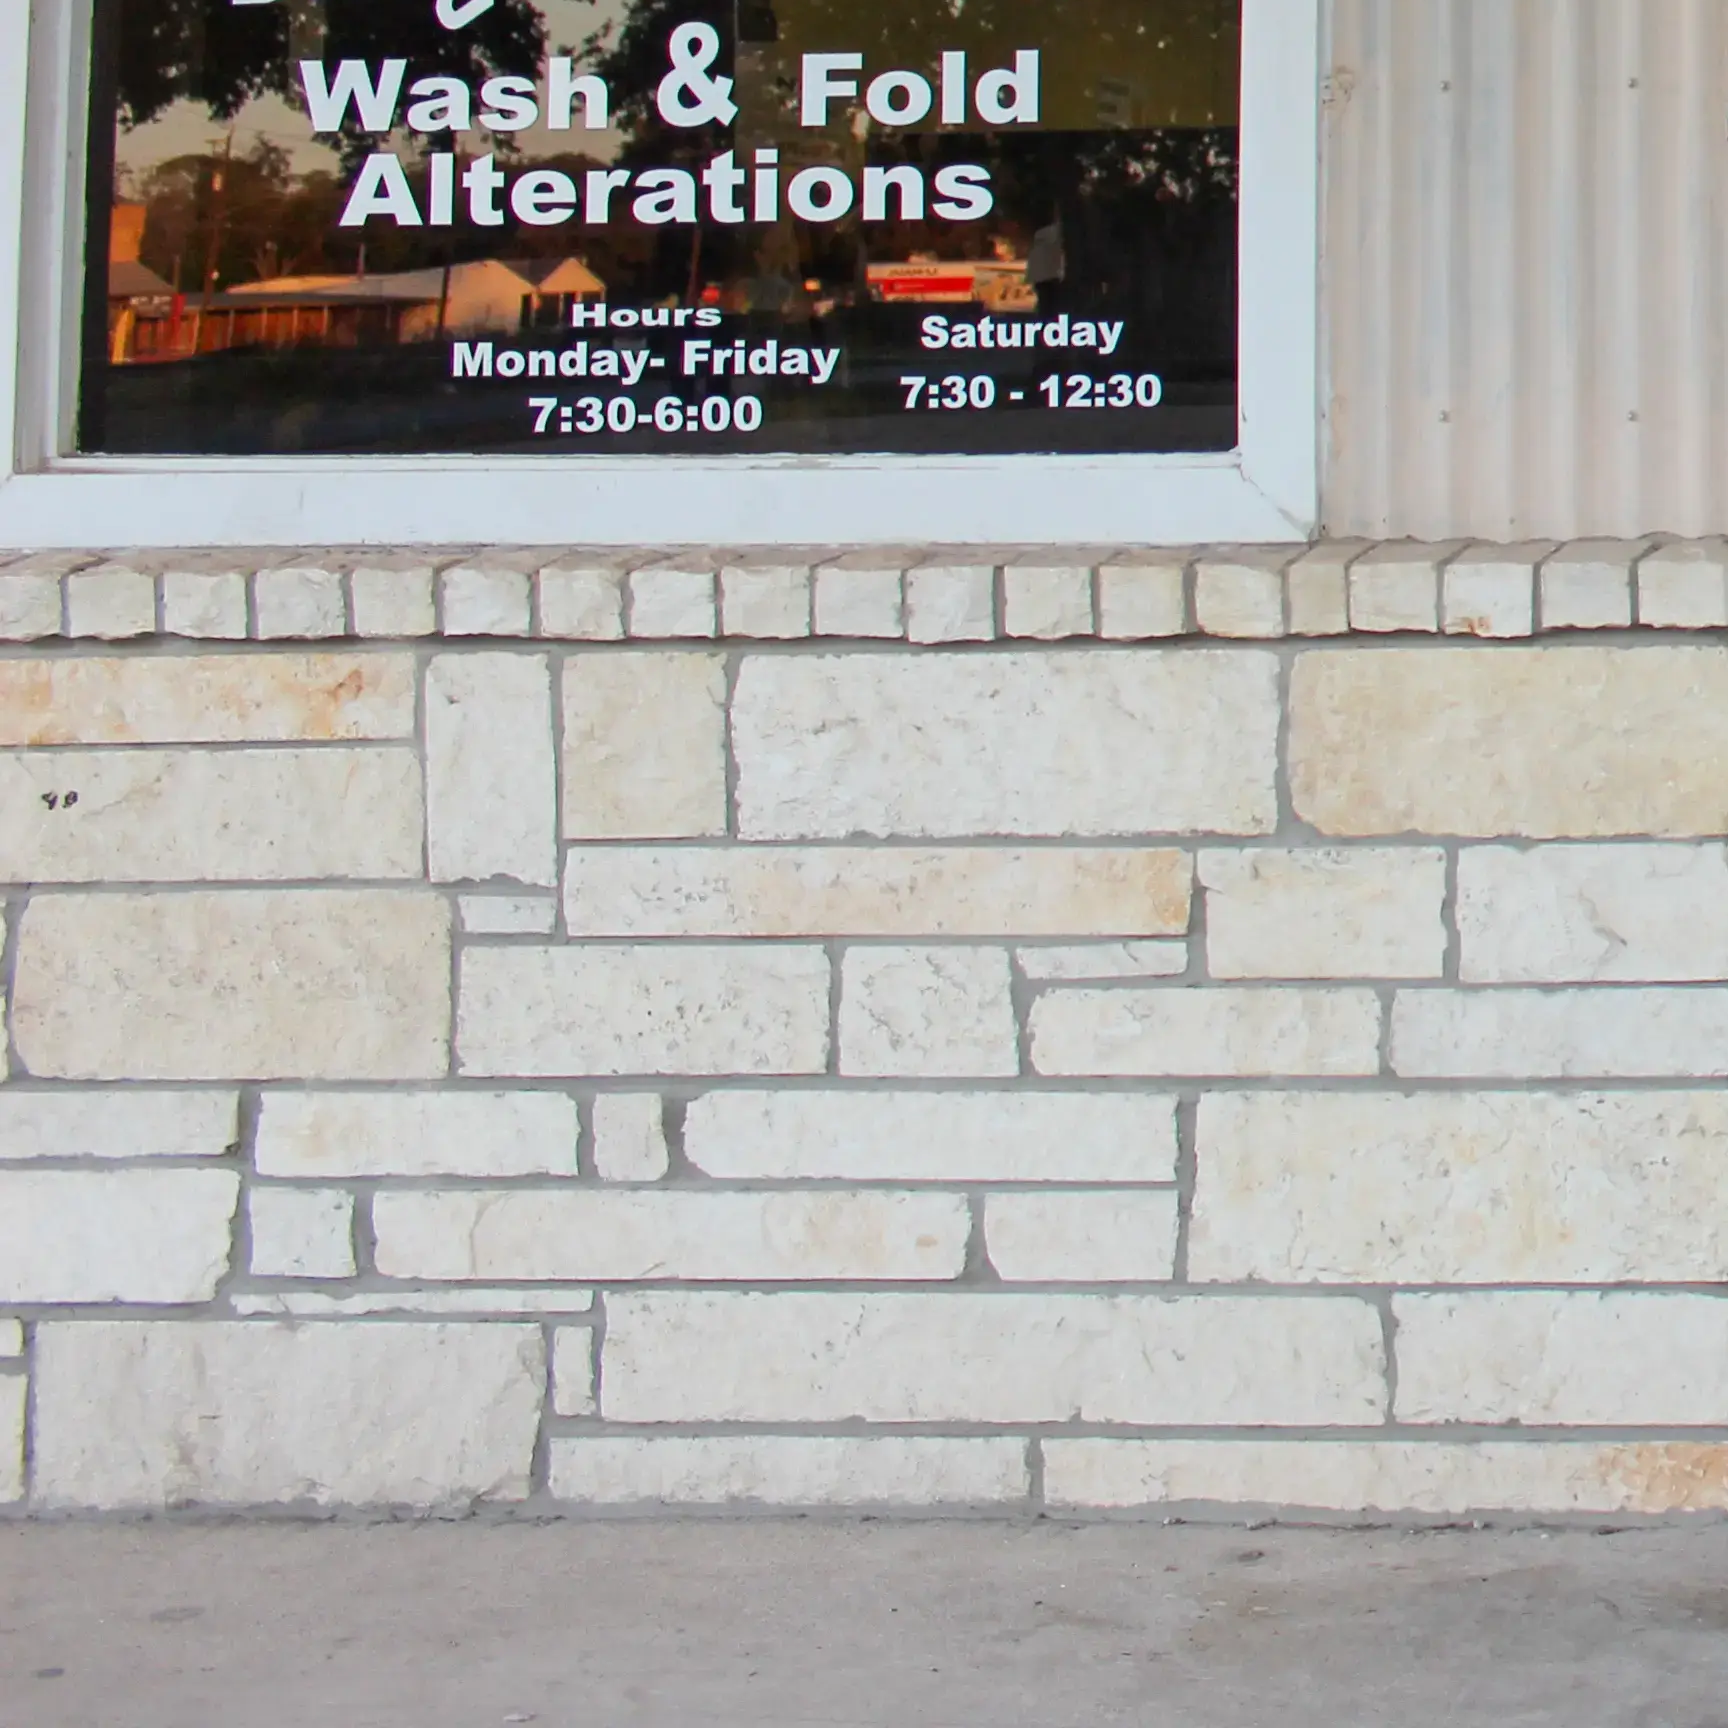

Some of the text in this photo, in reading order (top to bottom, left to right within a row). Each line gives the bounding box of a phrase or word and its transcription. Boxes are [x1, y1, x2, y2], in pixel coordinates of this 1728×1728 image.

[300, 22, 1038, 134] Wash & Fold
[338, 150, 994, 227] Alterations
[573, 303, 721, 327] Hours
[921, 314, 1123, 354] Saturday
[684, 340, 839, 383] Friday
[901, 376, 994, 408] 7:30
[1040, 374, 1161, 407] 12:30
[529, 396, 761, 432] 7:30-6:00
